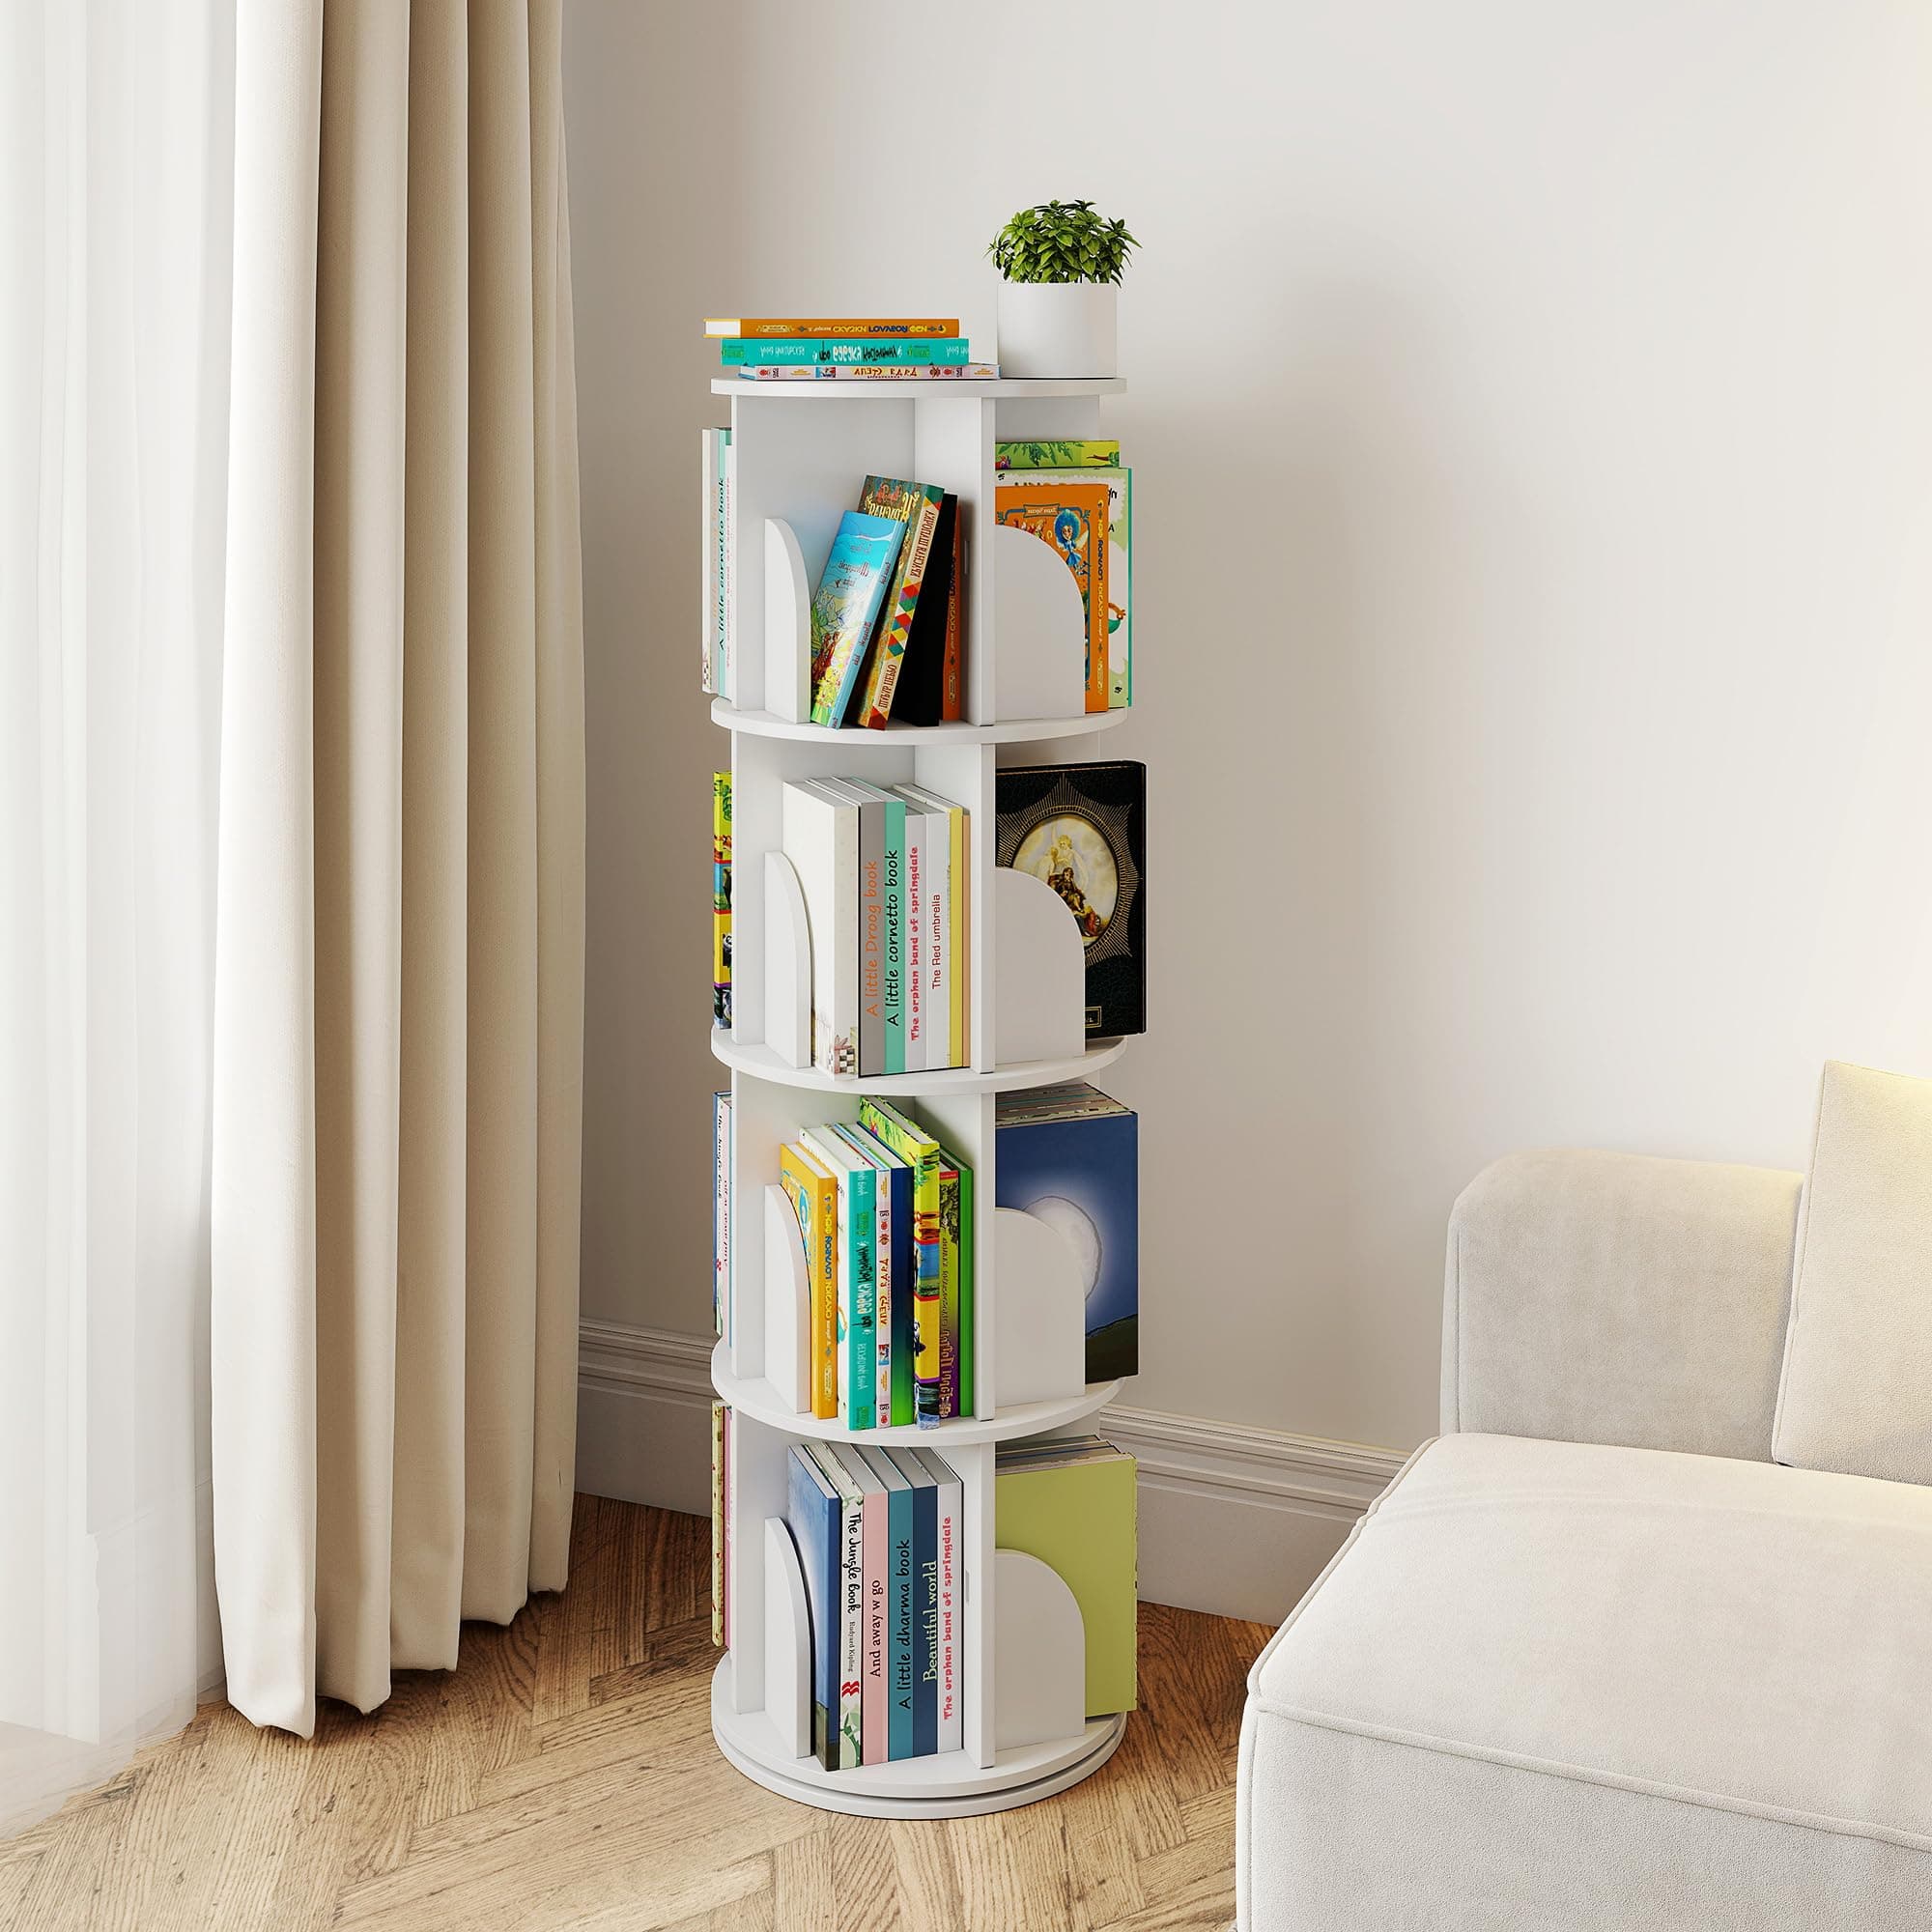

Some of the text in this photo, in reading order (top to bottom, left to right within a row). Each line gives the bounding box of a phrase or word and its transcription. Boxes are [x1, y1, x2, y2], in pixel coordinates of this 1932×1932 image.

[863, 860, 881, 1018] A little Droog book
[884, 849, 899, 1027] A little cornetto book
[909, 845, 921, 1041] The orphan band of springdale
[931, 894, 942, 990] The Red umbrella
[842, 1537, 861, 1579] Jungle
[847, 1513, 862, 1534] The
[869, 1579, 884, 1678] And away w go
[895, 1539, 911, 1710] A little dharma book
[922, 1560, 938, 1682] Beautiful world
[942, 1516, 953, 1720] The orphan band of springdale
